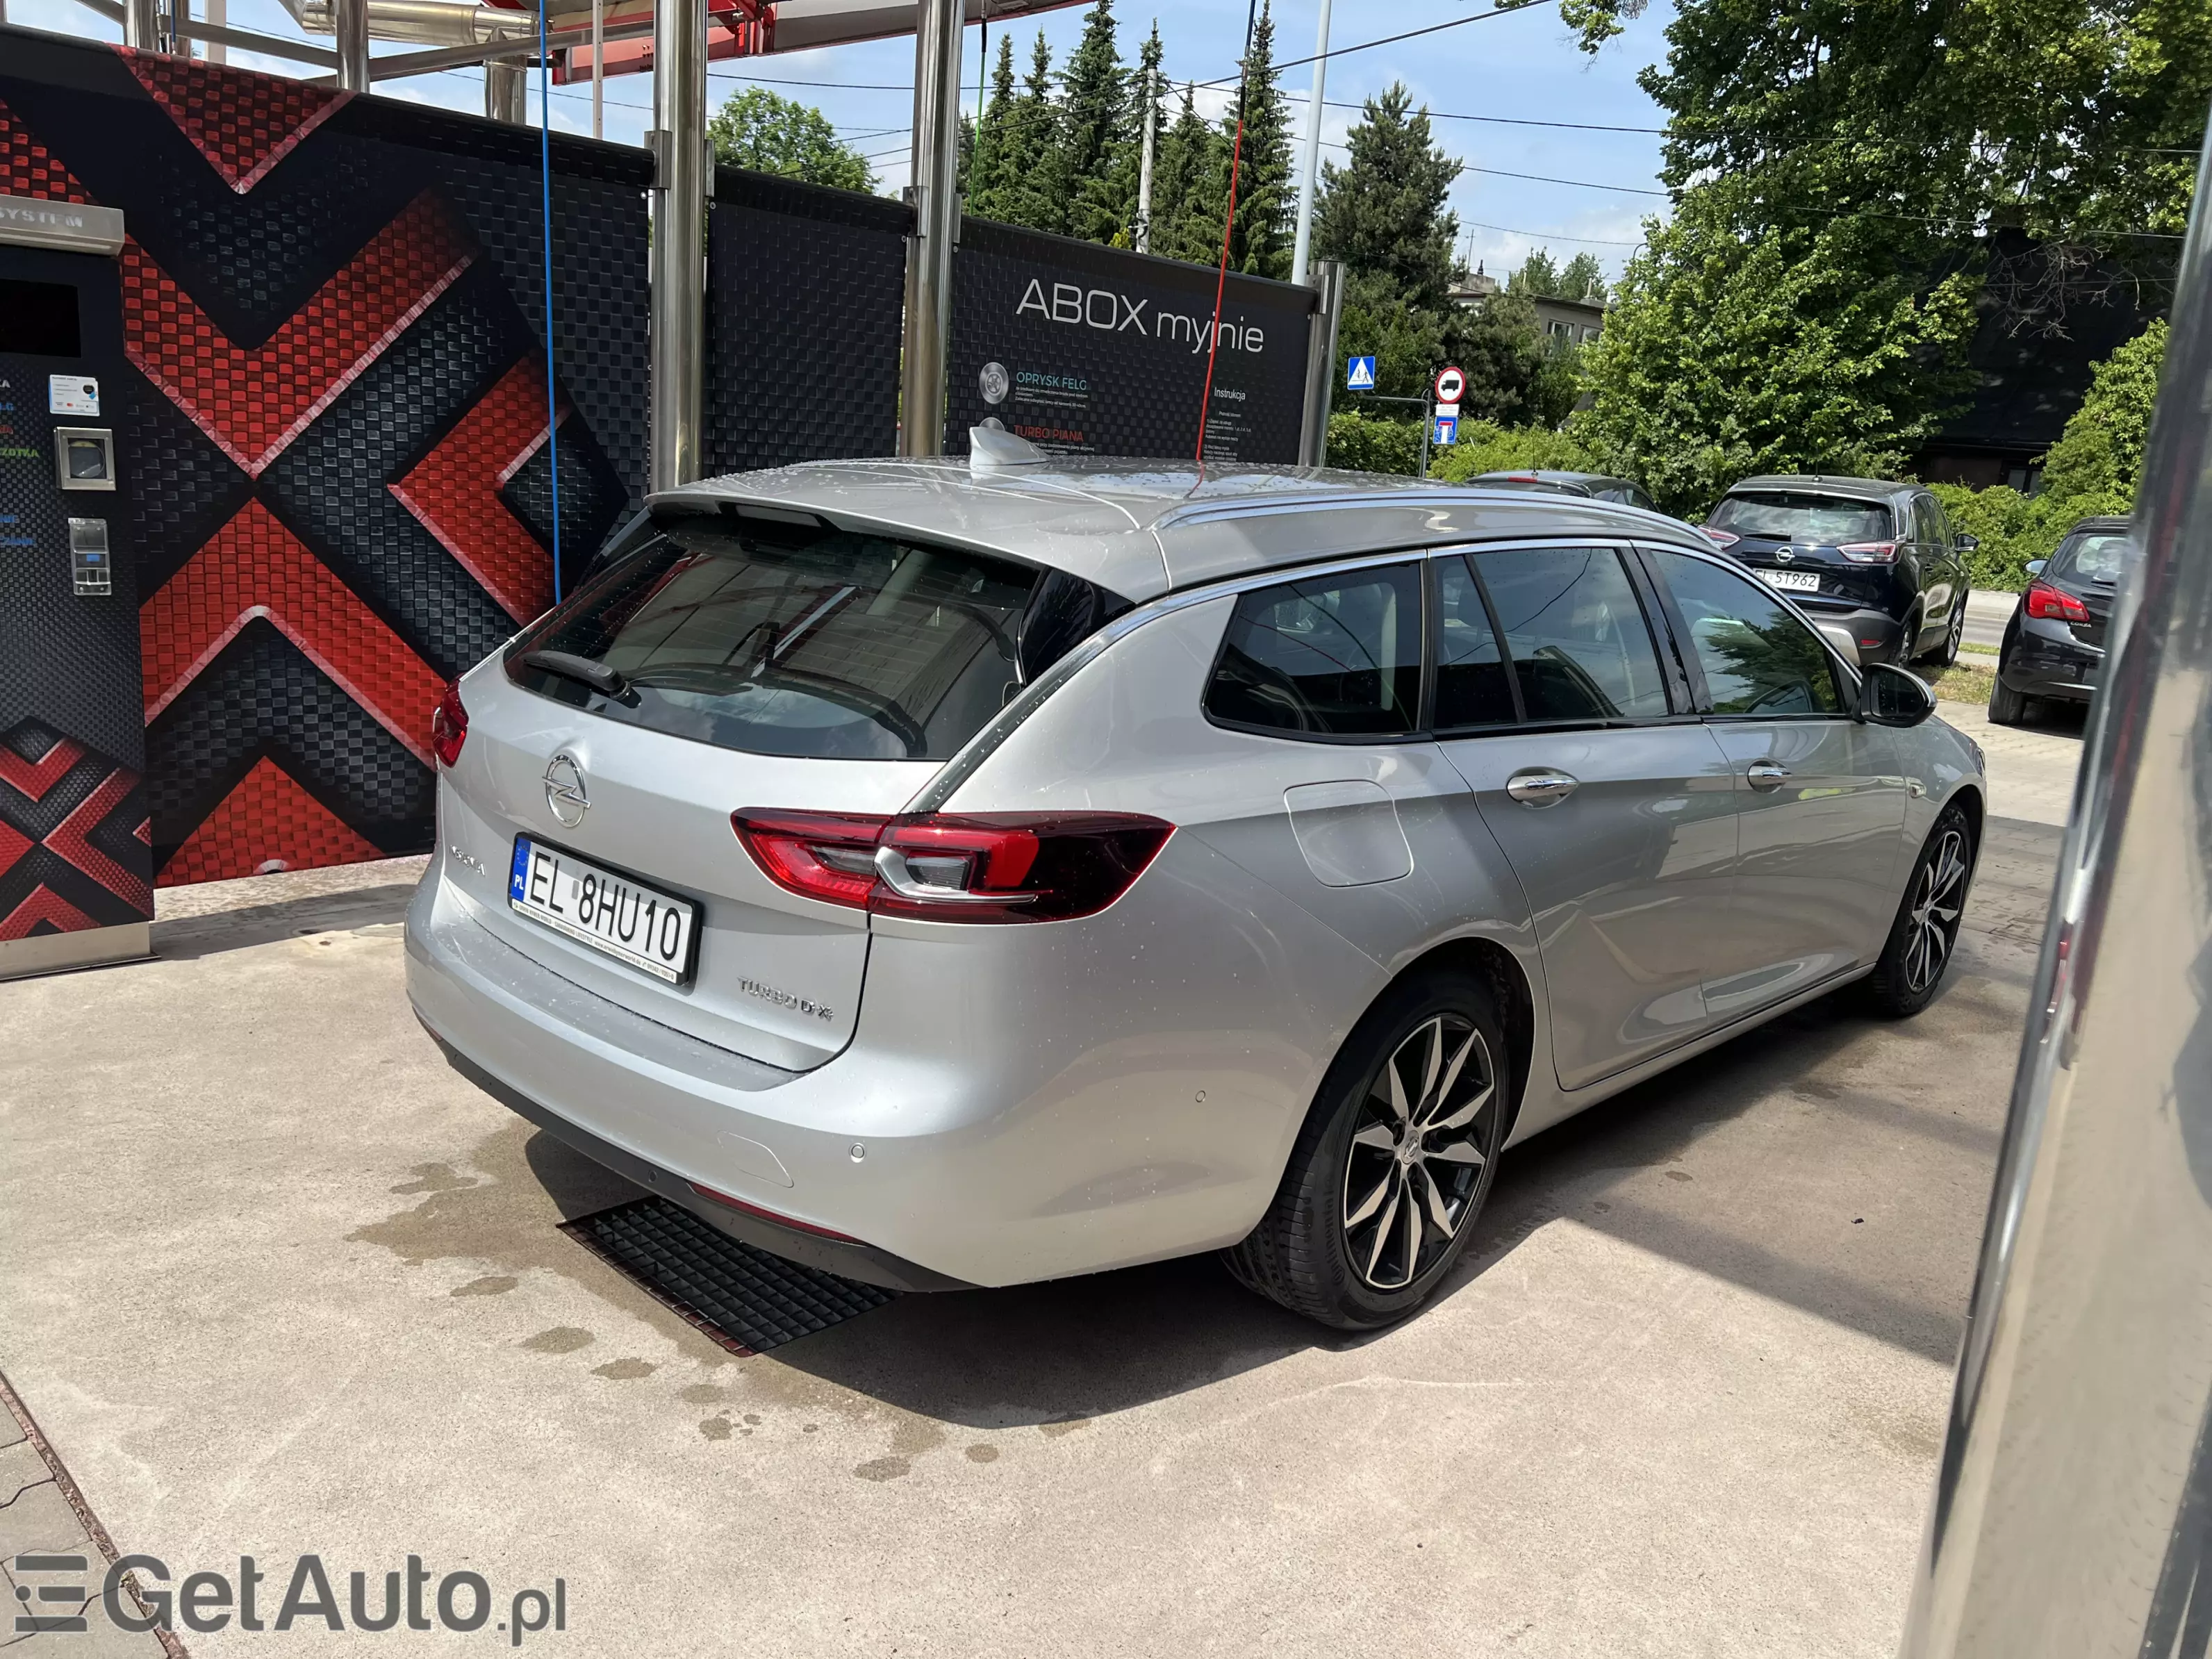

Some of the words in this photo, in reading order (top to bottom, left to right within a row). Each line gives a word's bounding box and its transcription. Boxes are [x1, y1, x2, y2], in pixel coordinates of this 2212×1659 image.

[1016, 279, 1148, 335] ABOX
[1157, 311, 1264, 354] myjnie
[1016, 372, 1059, 387] OPRYSK
[1062, 377, 1087, 390] FELG
[1214, 386, 1246, 402] Instrukcja
[1014, 425, 1050, 438] TURBO
[1053, 429, 1083, 442] PIANA
[1775, 572, 1816, 587] 5T962
[514, 874, 524, 890] PL
[530, 851, 563, 914] EL
[578, 873, 681, 961] 8HU10
[736, 975, 798, 1009] TURBO
